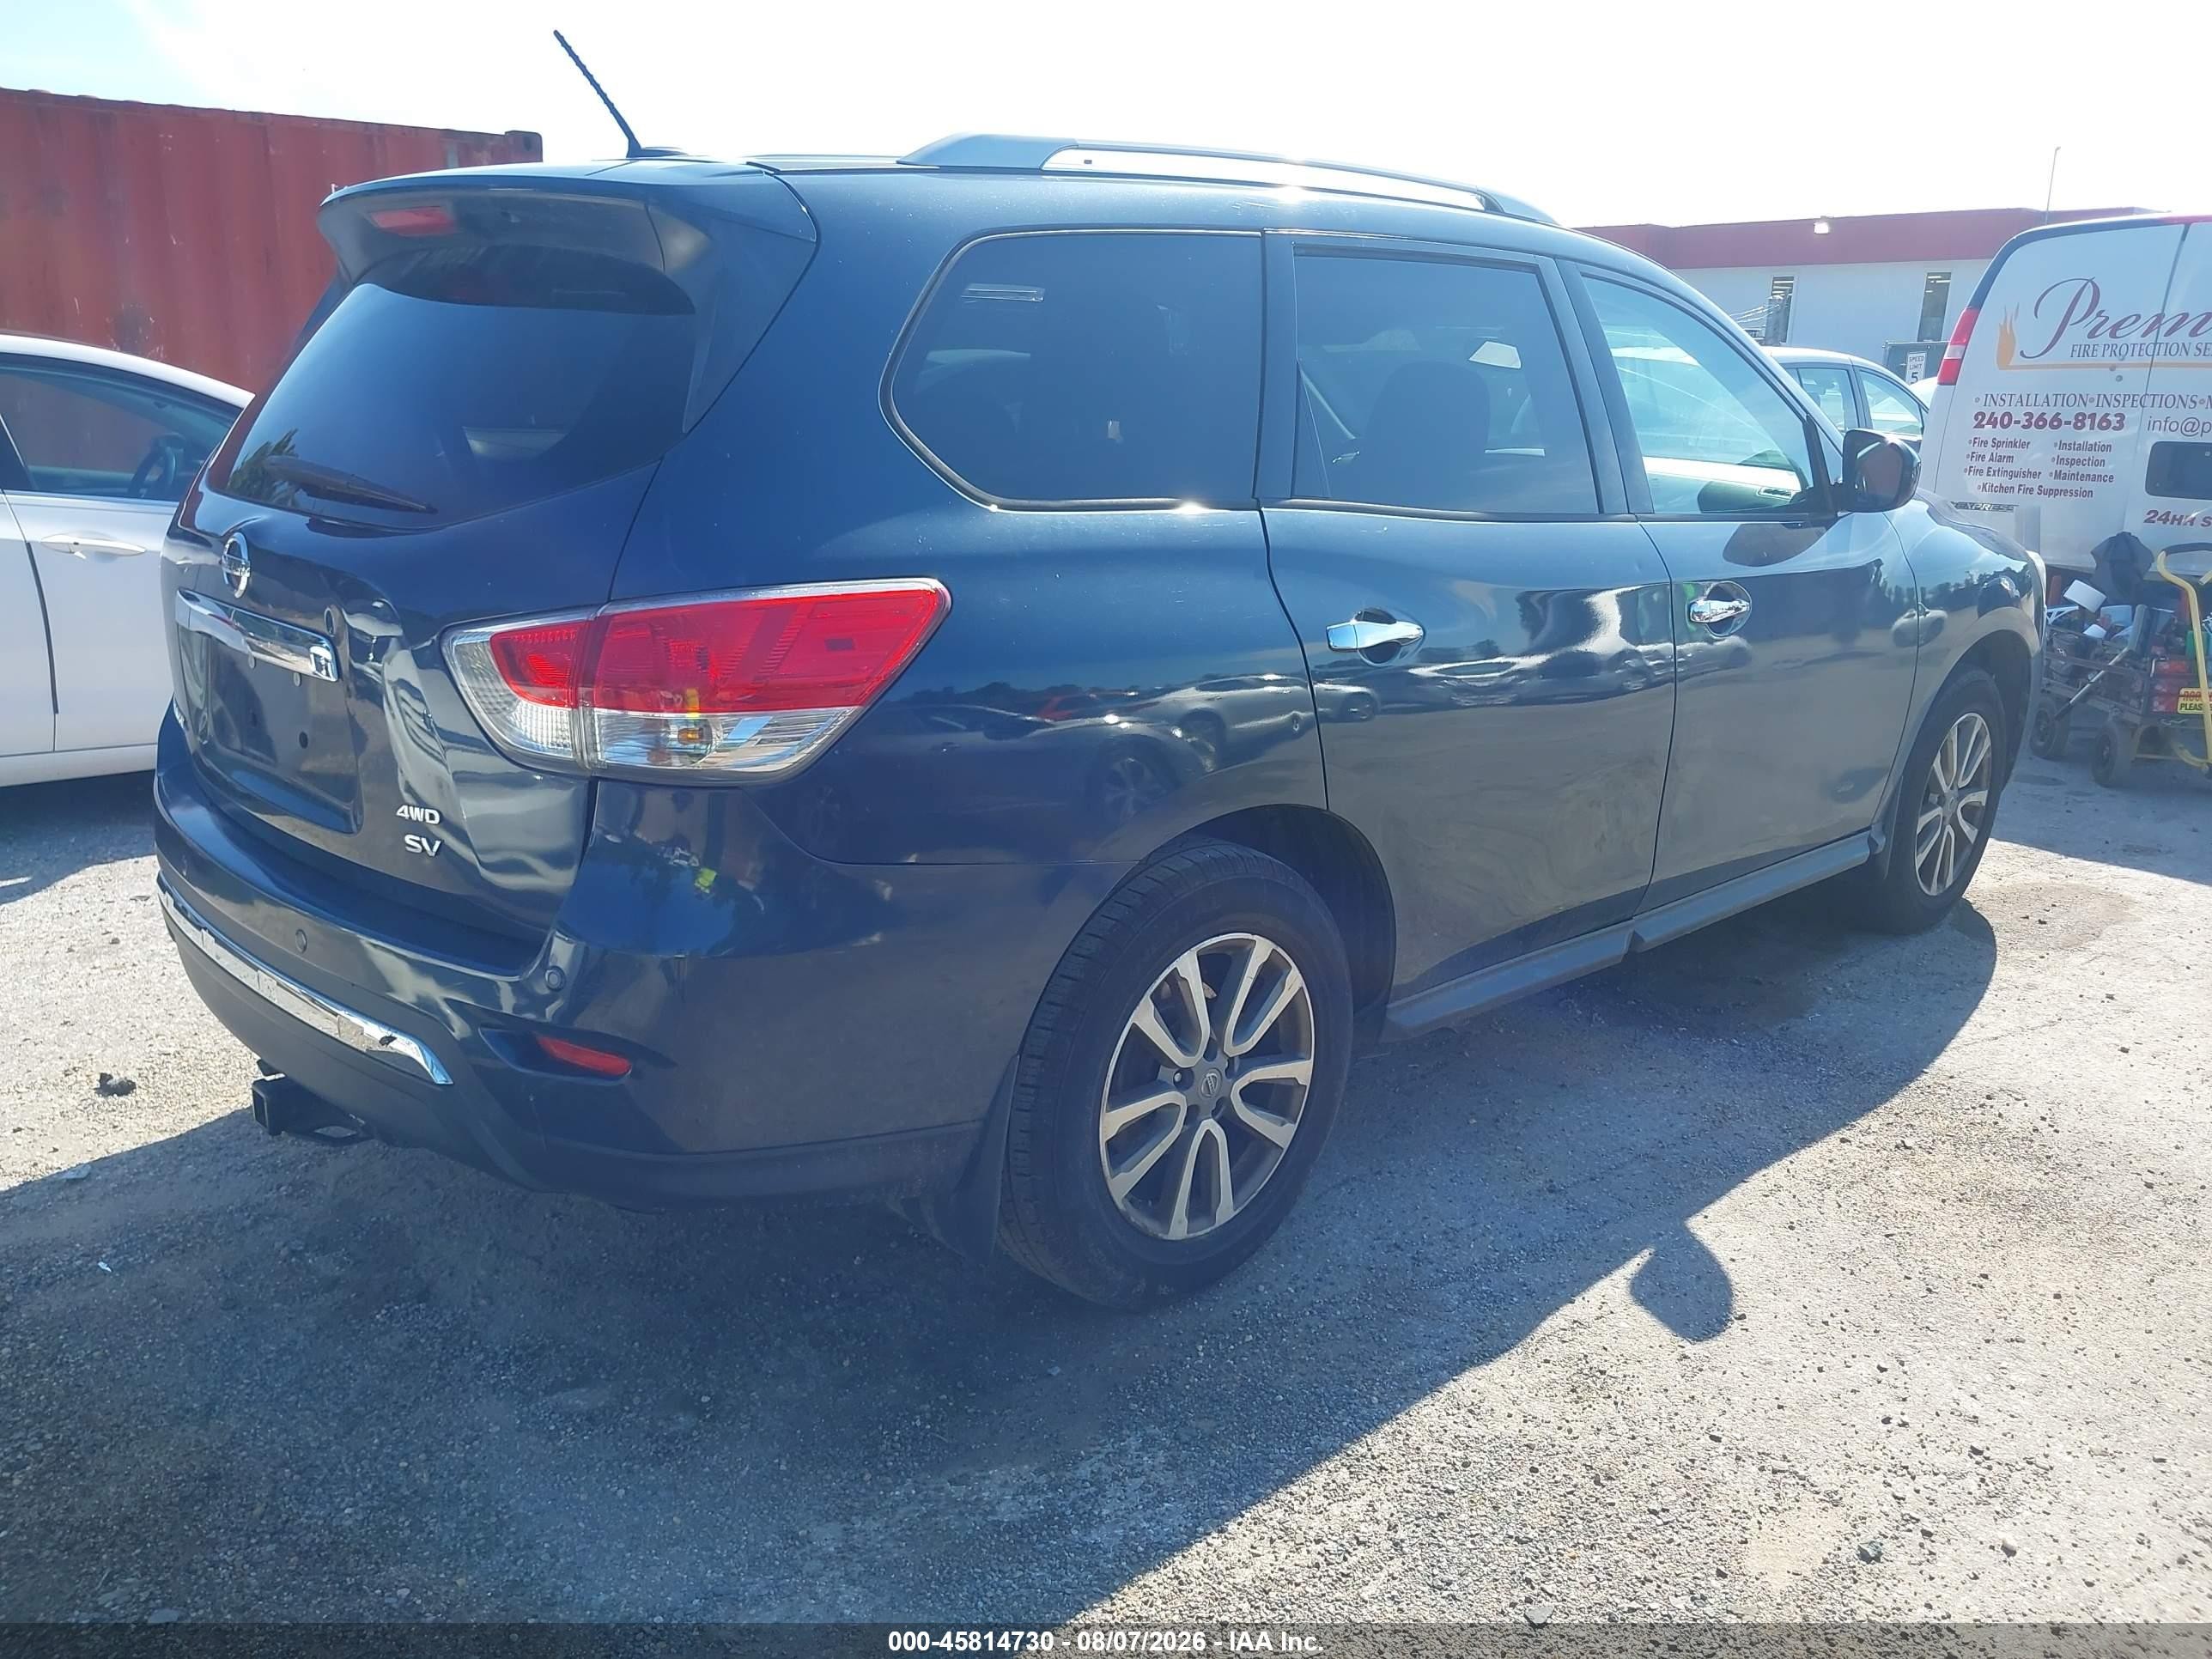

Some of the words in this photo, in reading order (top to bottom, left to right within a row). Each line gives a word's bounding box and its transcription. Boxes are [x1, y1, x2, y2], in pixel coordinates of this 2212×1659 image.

[2070, 343, 2099, 357] FIRE
[2101, 342, 2191, 358] PROTECTION
[2194, 342, 2212, 357] SE
[1911, 372, 1918, 384] 5
[1983, 393, 2089, 407] INSTALLATION
[2095, 393, 2198, 409] INSPECTIONS
[1972, 411, 2125, 431] 240-366-8163
[1972, 437, 1988, 447] Fire
[1991, 437, 2031, 450] Sprinkler
[2058, 440, 2112, 453] Installation
[1970, 452, 1985, 462] Fire
[1988, 453, 2014, 464] Alarm
[2056, 455, 2106, 468] Inspection
[1967, 466, 1984, 477] Fire
[1986, 466, 2041, 480] Extinguisher
[2053, 470, 2114, 483] Maintenance
[1981, 483, 2014, 494] Kitchen
[2017, 484, 2034, 495] Fire
[2037, 485, 2094, 498] Suppression
[2180, 702, 2203, 711] PLEAS
[396, 805, 441, 824] 4WD
[404, 834, 441, 857] SV
